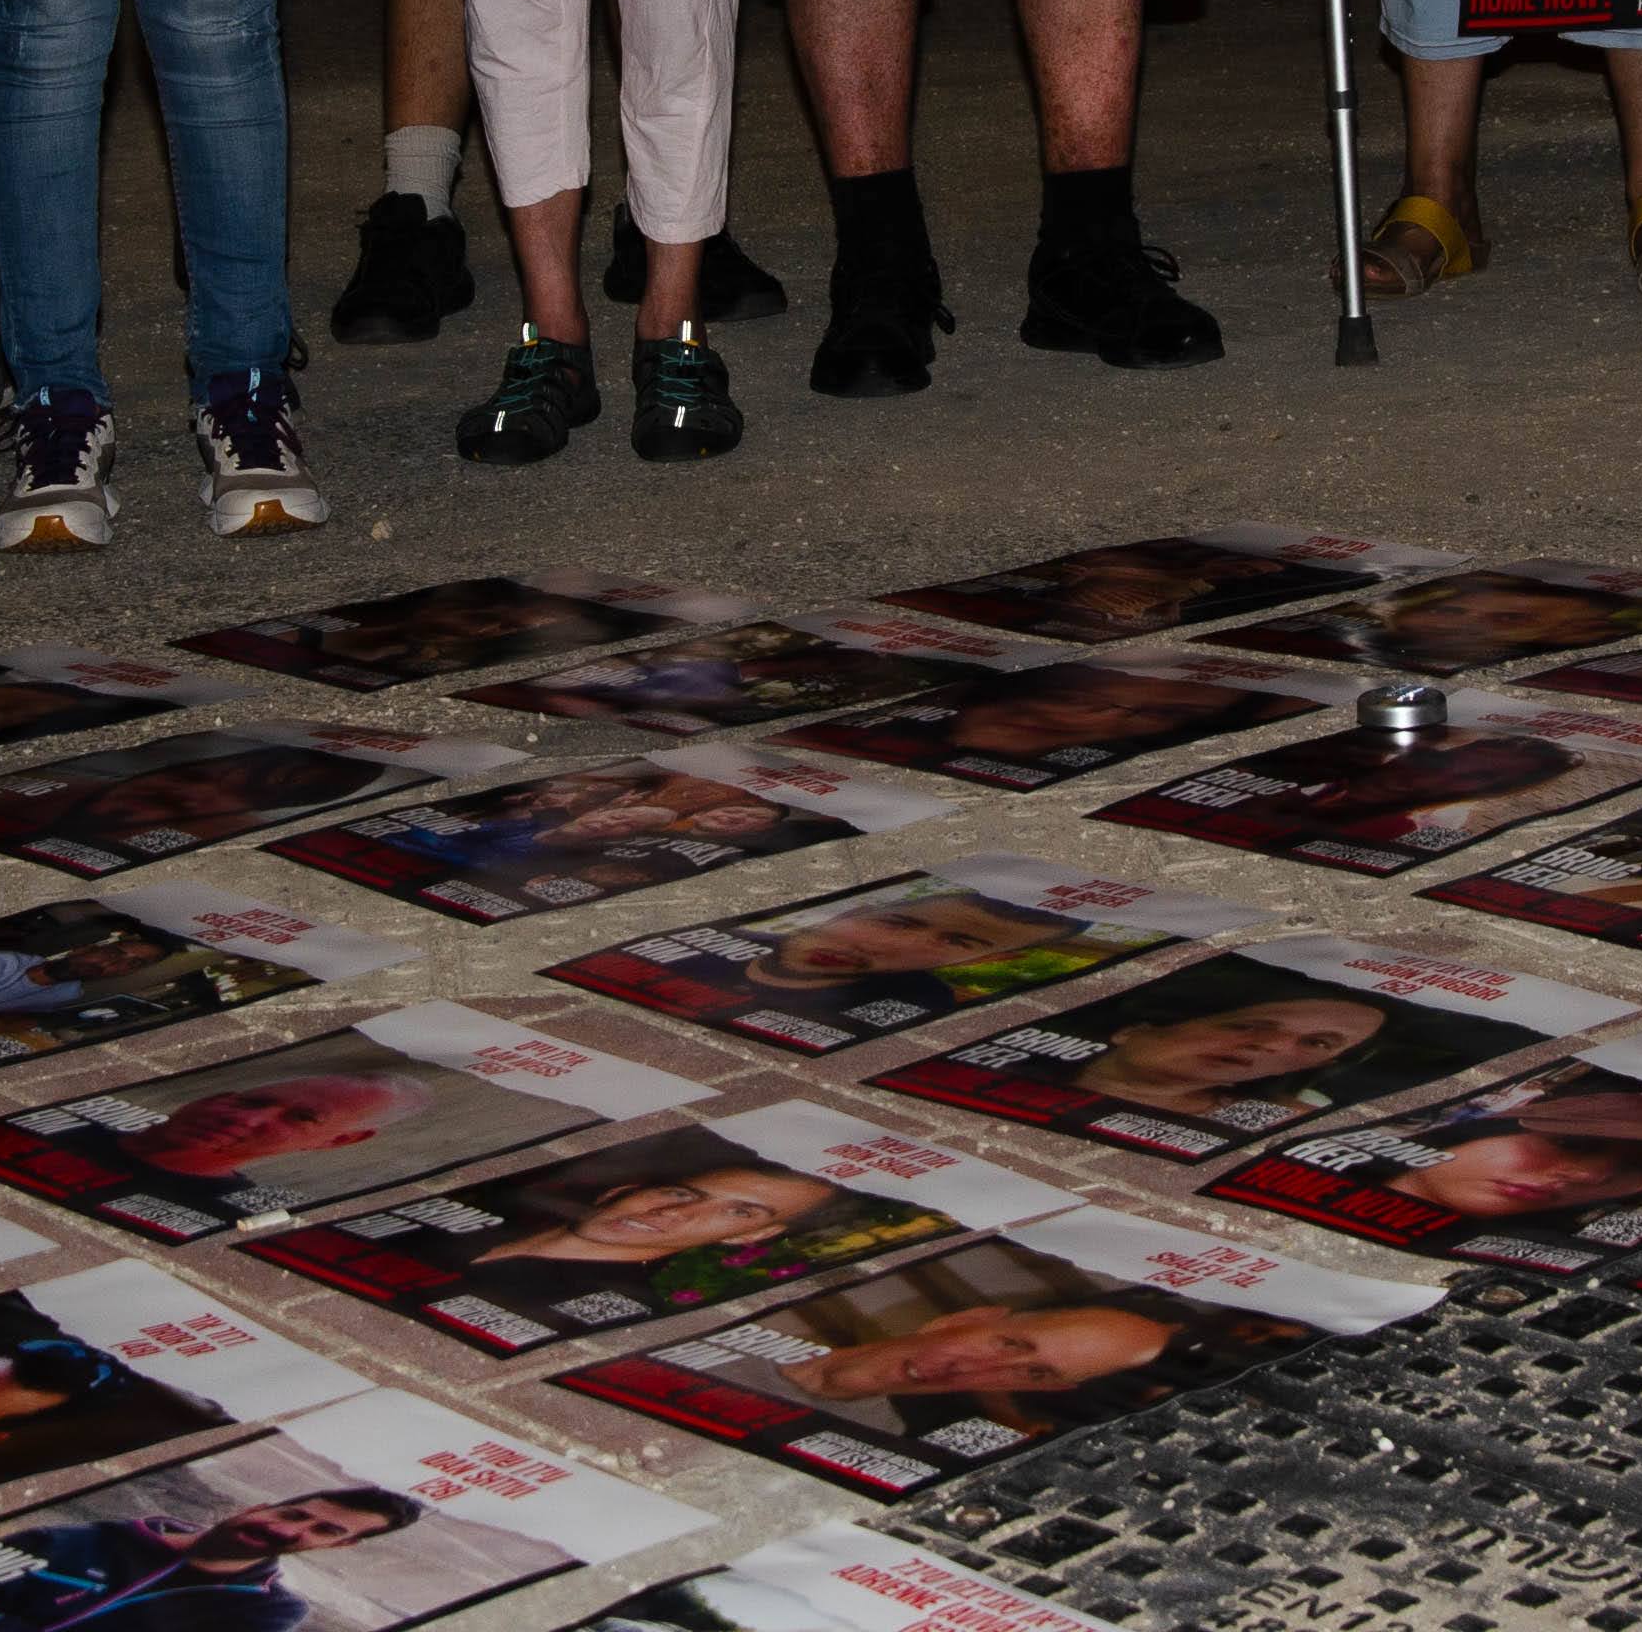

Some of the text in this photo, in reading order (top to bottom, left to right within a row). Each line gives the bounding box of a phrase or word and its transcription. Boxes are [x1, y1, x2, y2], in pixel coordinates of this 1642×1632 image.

[1492, 862, 1561, 889] HER
[1532, 844, 1642, 882] BRING
[1281, 1140, 1359, 1174] HER
[1329, 1130, 1458, 1170] BRING
[830, 1563, 942, 1610] ADRIENNE
